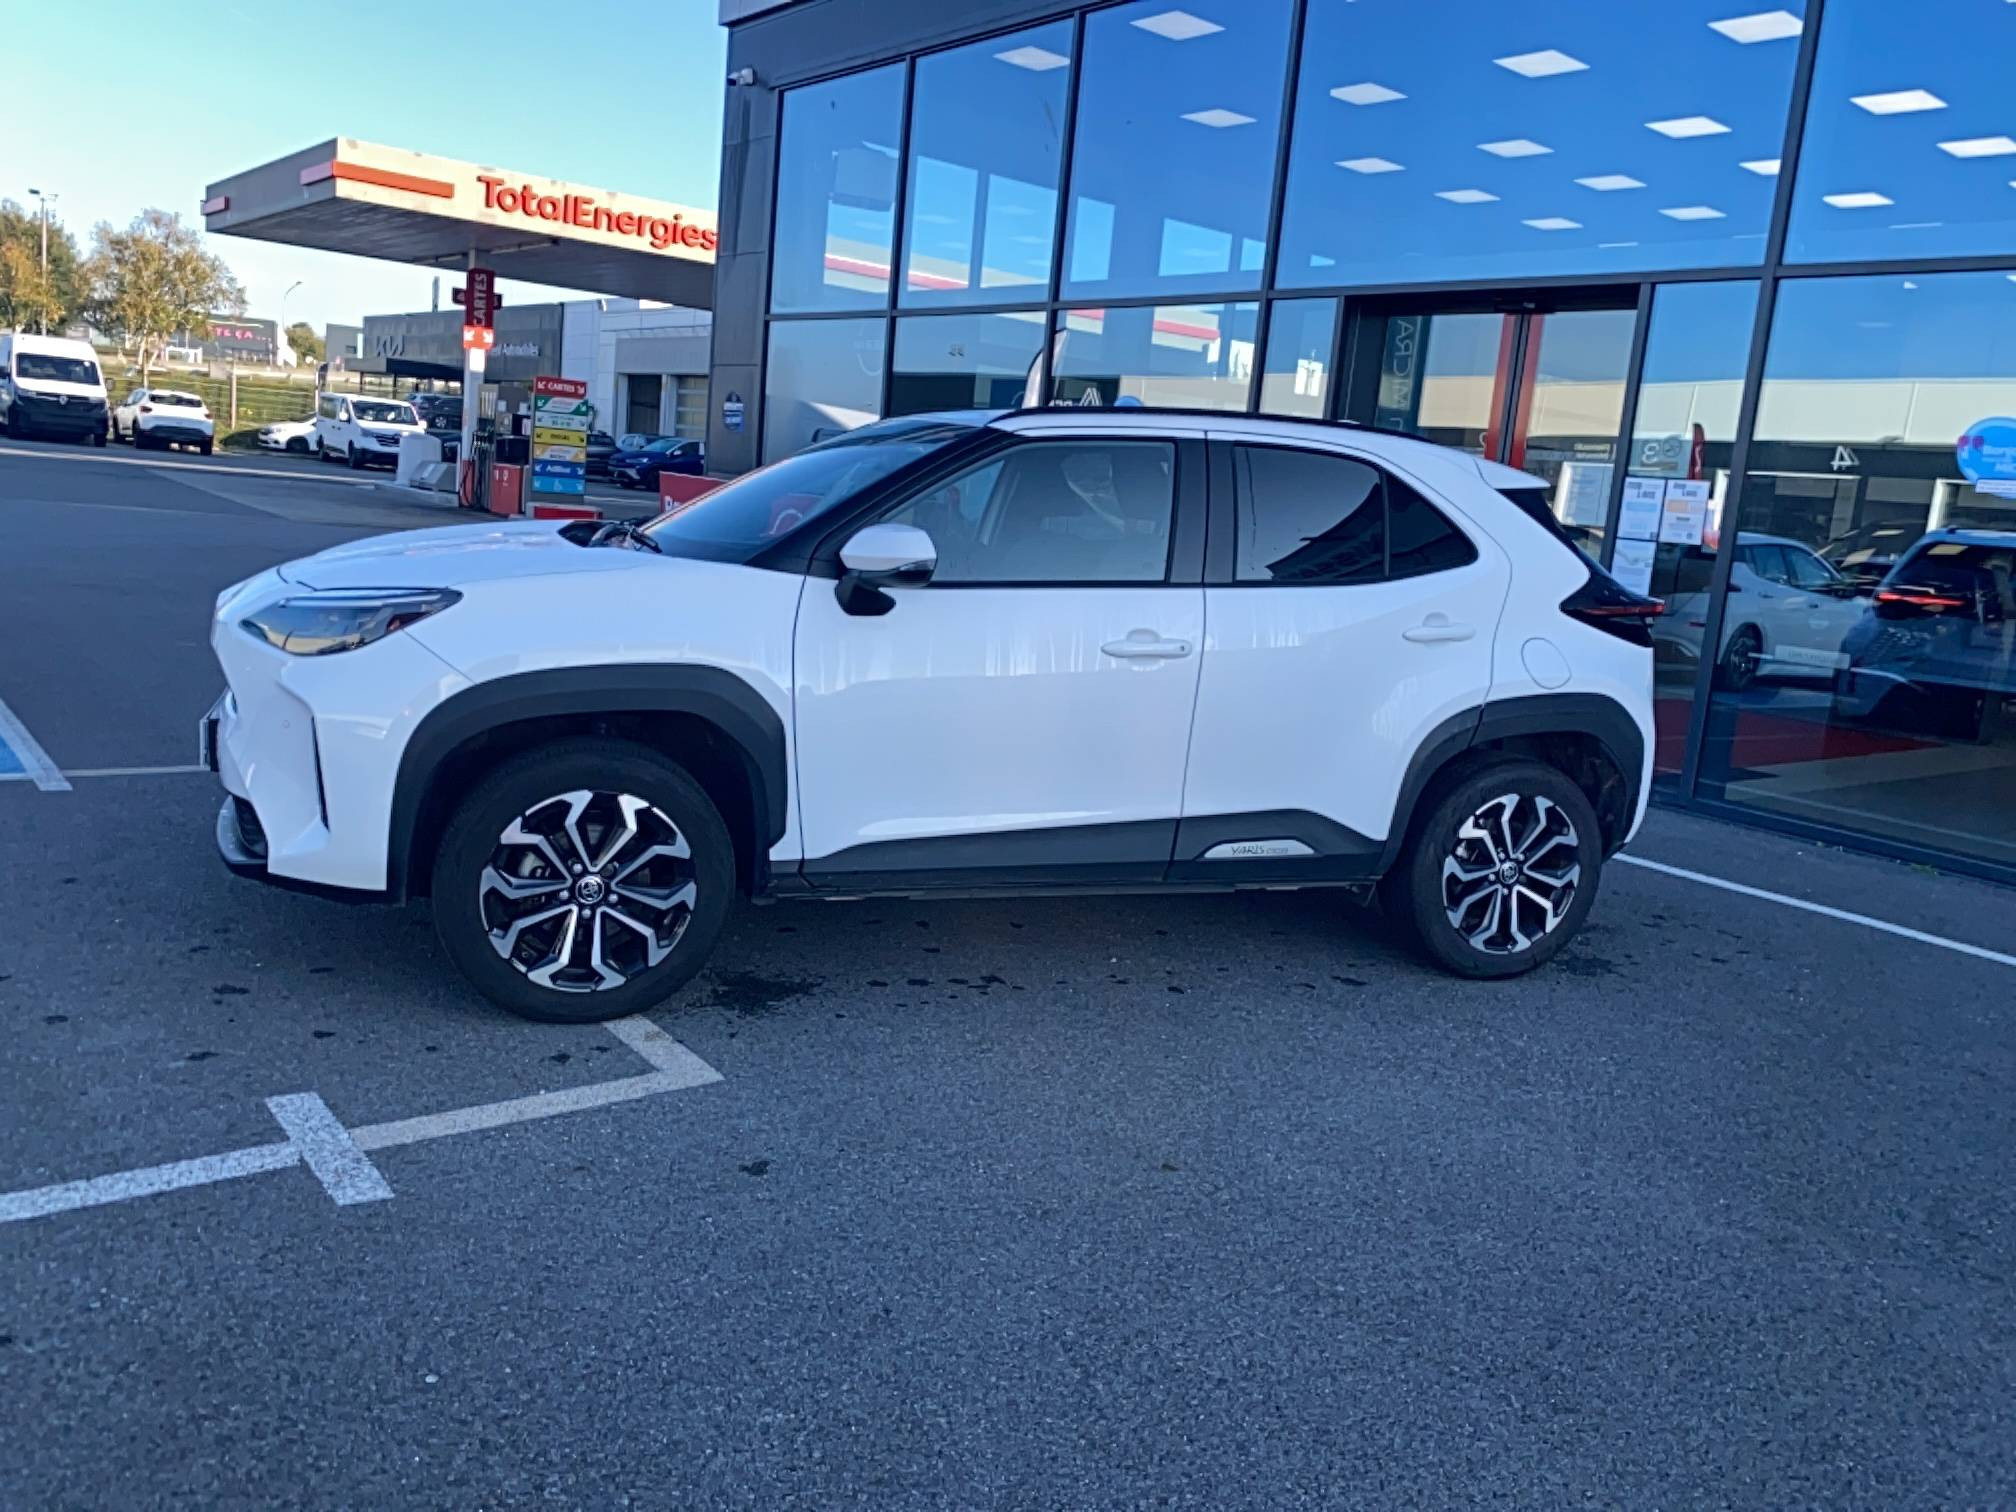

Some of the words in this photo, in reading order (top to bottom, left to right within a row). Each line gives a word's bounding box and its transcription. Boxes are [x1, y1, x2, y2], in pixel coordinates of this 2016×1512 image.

[477, 175, 717, 250] TotalEnergies
[547, 382, 575, 393] CARTES
[1231, 844, 1265, 856] YARIS
